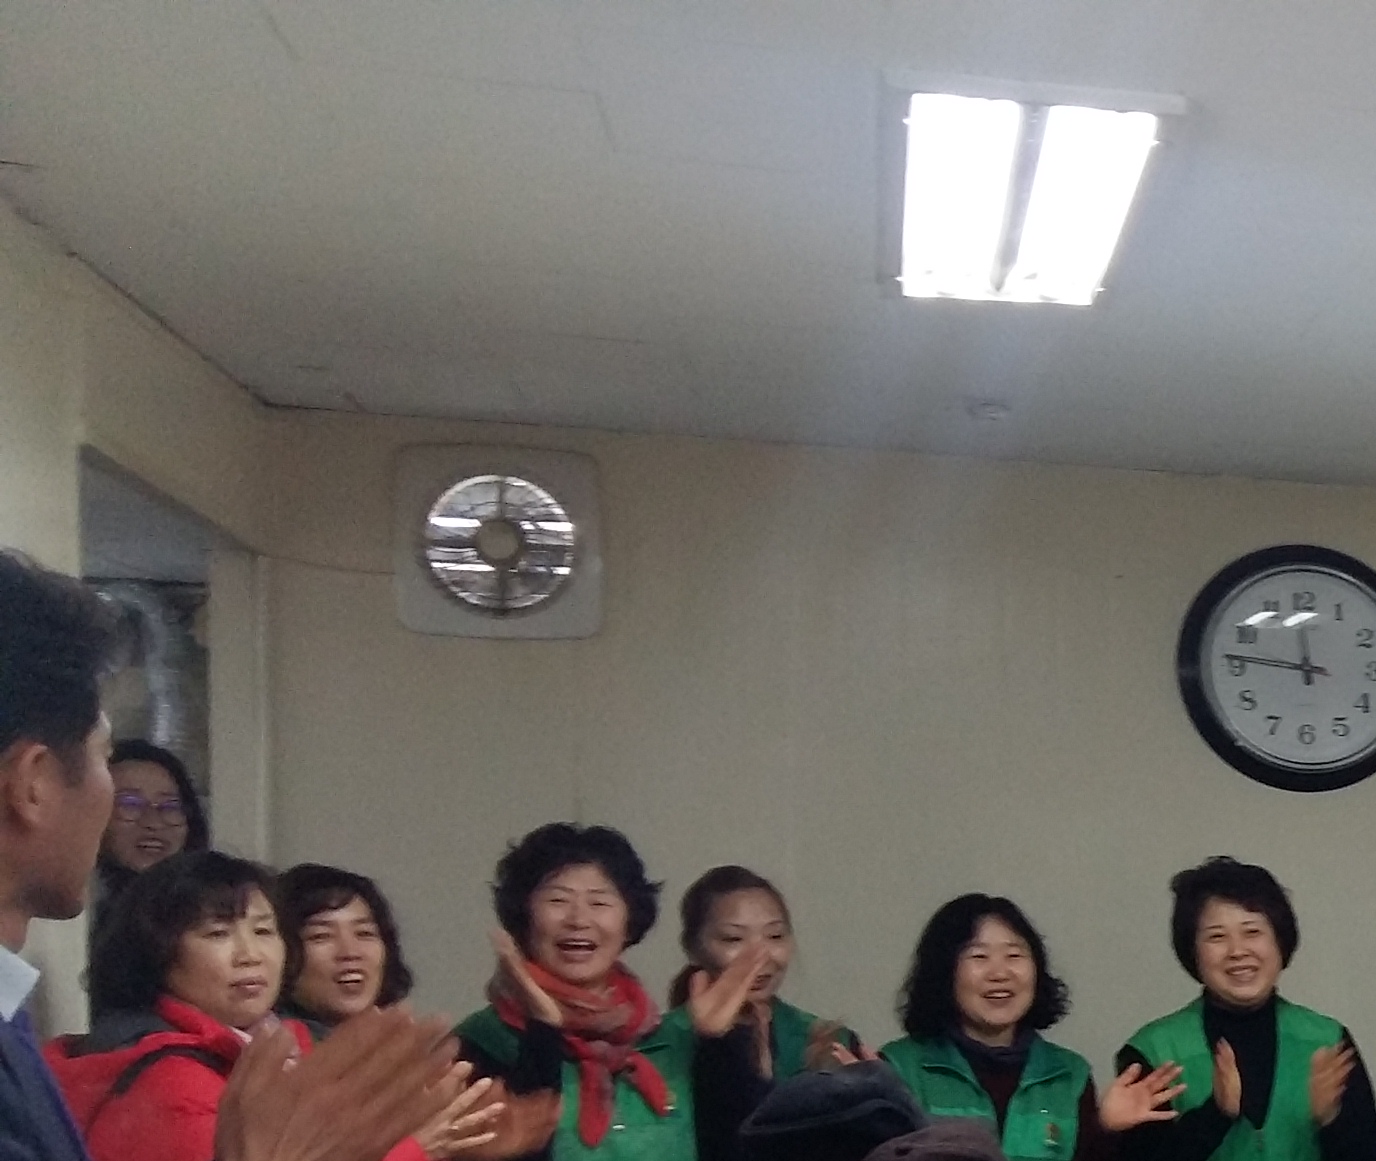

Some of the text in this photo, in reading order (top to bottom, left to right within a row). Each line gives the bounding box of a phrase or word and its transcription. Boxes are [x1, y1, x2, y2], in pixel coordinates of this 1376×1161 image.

[1293, 591, 1316, 611] 12
[1334, 603, 1344, 621] 1
[1356, 628, 1375, 649] 2
[1237, 690, 1258, 710] 8
[1353, 693, 1371, 713] 4
[1266, 715, 1282, 735] 7
[1297, 724, 1316, 744] 6
[1332, 717, 1350, 737] 5
